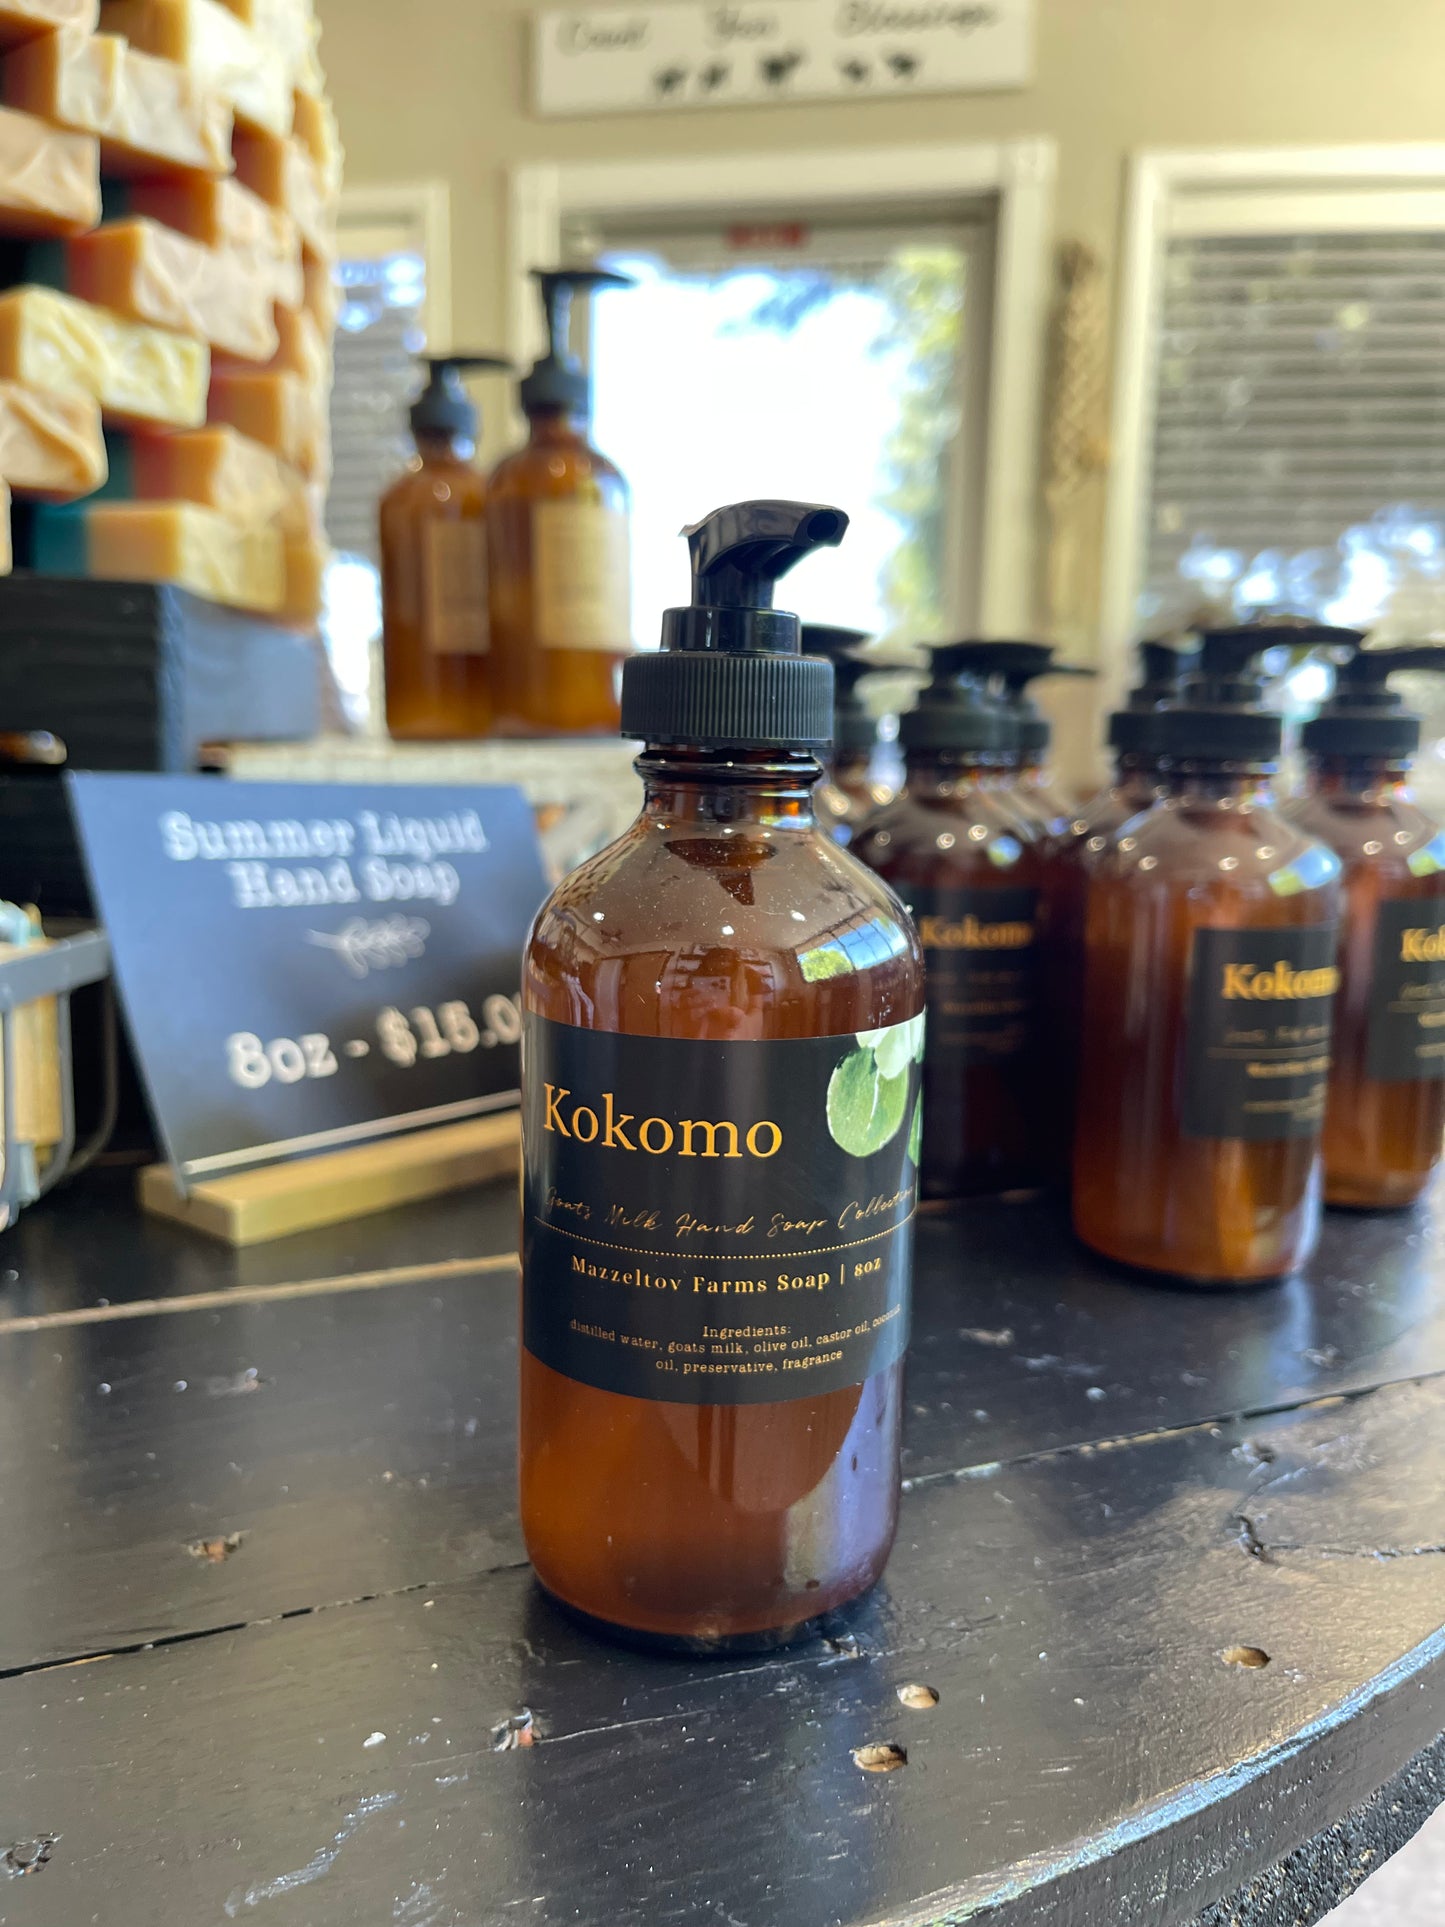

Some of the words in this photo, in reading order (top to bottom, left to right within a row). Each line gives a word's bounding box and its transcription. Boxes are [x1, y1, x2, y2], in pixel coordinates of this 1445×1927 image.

[160, 810, 354, 861] Summer
[358, 808, 490, 861] Liquid
[226, 857, 361, 908] Hand
[358, 855, 460, 905] Soap
[225, 1031, 338, 1089] 8oz
[375, 991, 521, 1068] $15.0
[543, 1082, 783, 1158] Kokomo
[604, 1204, 662, 1231] Milk
[675, 1212, 755, 1238] Hand
[767, 1212, 828, 1238] Soap
[571, 1255, 682, 1291] Mazzeltov
[692, 1276, 767, 1293] Farms
[777, 1272, 830, 1291] Soap
[854, 1256, 882, 1278] 8oz
[570, 1318, 615, 1342] distilled
[668, 1341, 706, 1354] goats
[753, 1341, 787, 1352] olive
[816, 1328, 852, 1345] castor
[702, 1325, 791, 1339] Ingredients:
[782, 1350, 843, 1369] fragrance
